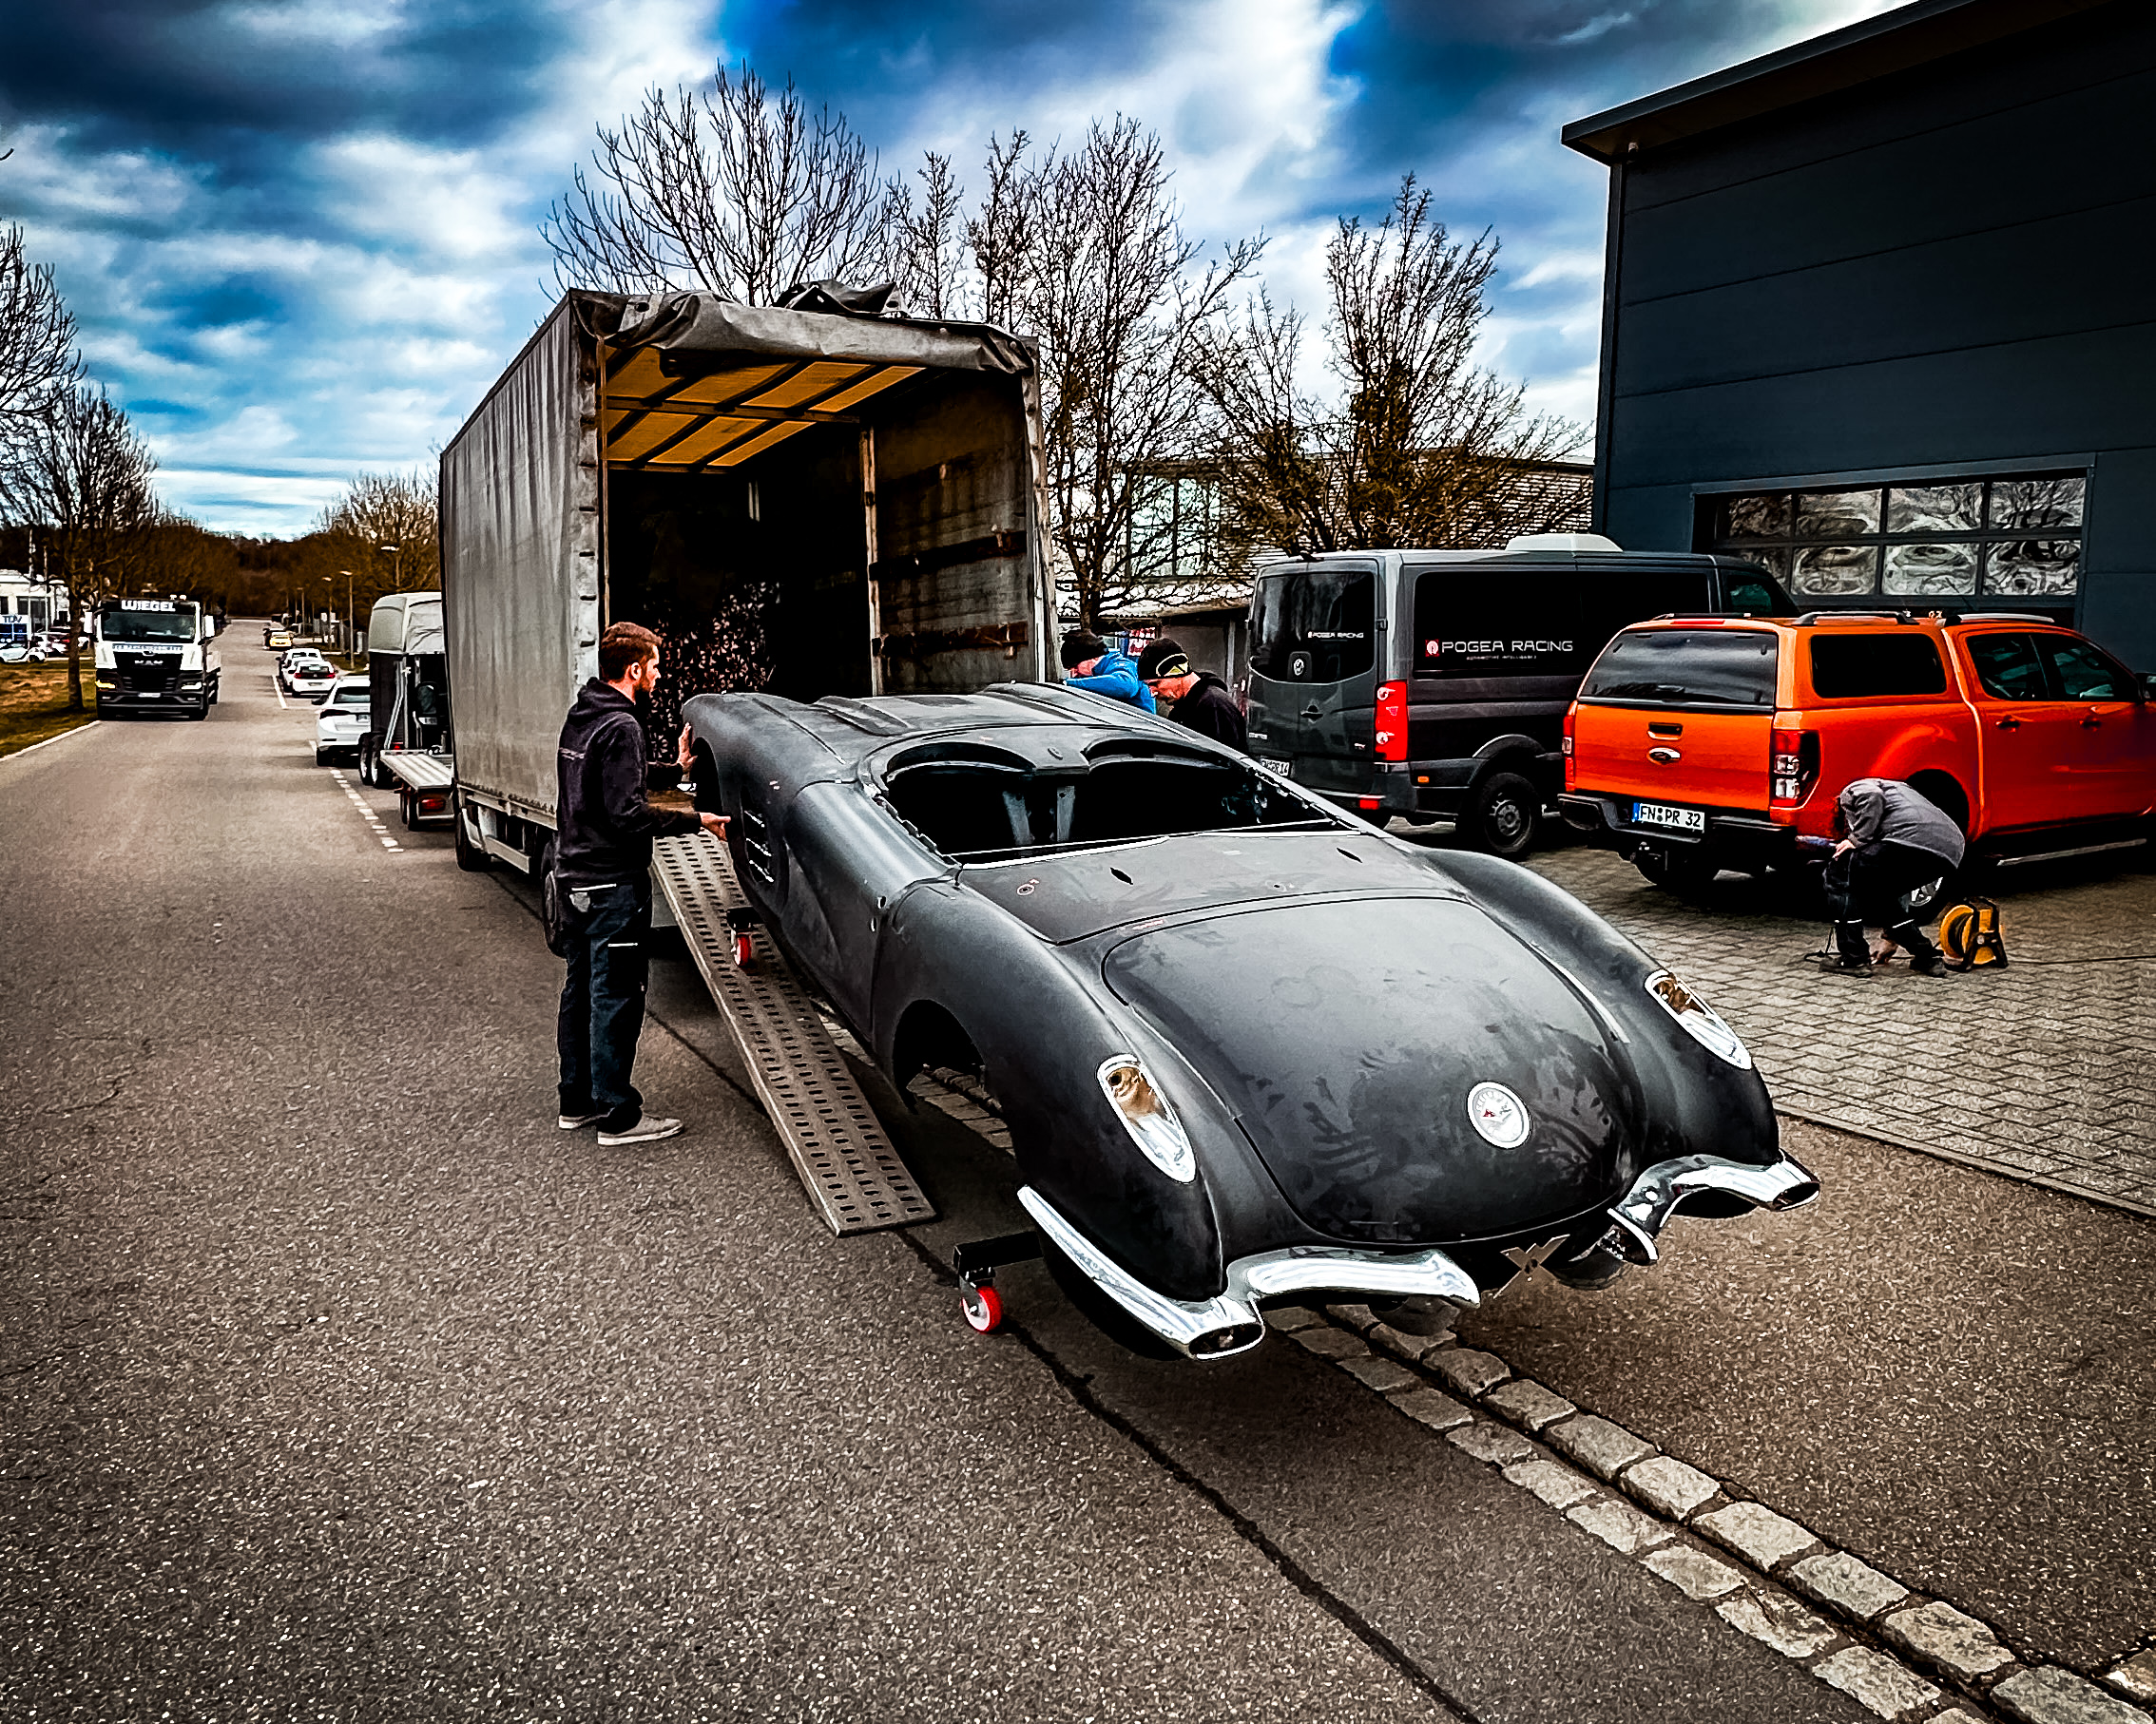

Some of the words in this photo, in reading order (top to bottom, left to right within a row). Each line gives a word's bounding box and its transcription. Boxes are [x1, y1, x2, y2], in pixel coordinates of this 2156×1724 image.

[1441, 641, 1504, 653] POGEA
[1511, 641, 1573, 652] RACING
[1640, 806, 1656, 820] FN
[1665, 809, 1681, 825] PR
[1685, 812, 1701, 828] 32
